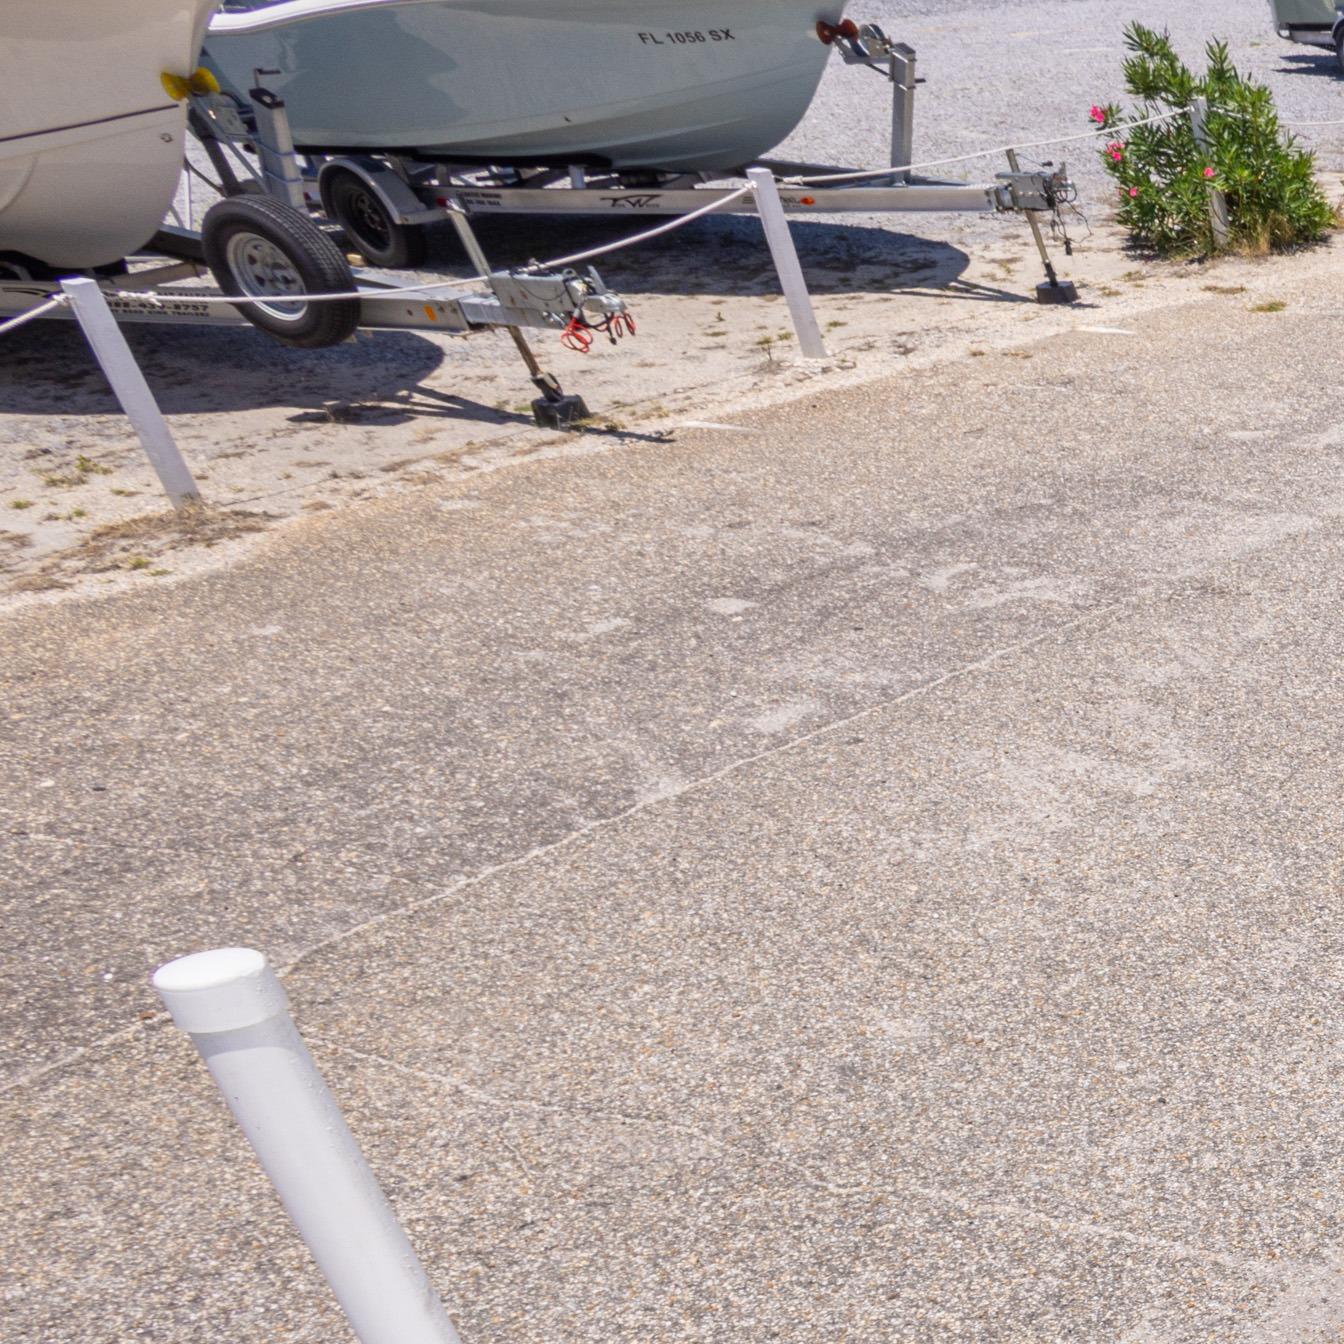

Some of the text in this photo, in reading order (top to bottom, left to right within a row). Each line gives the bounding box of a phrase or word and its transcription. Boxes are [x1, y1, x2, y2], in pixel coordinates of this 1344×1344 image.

[637, 28, 736, 45] FL 1056 SX
